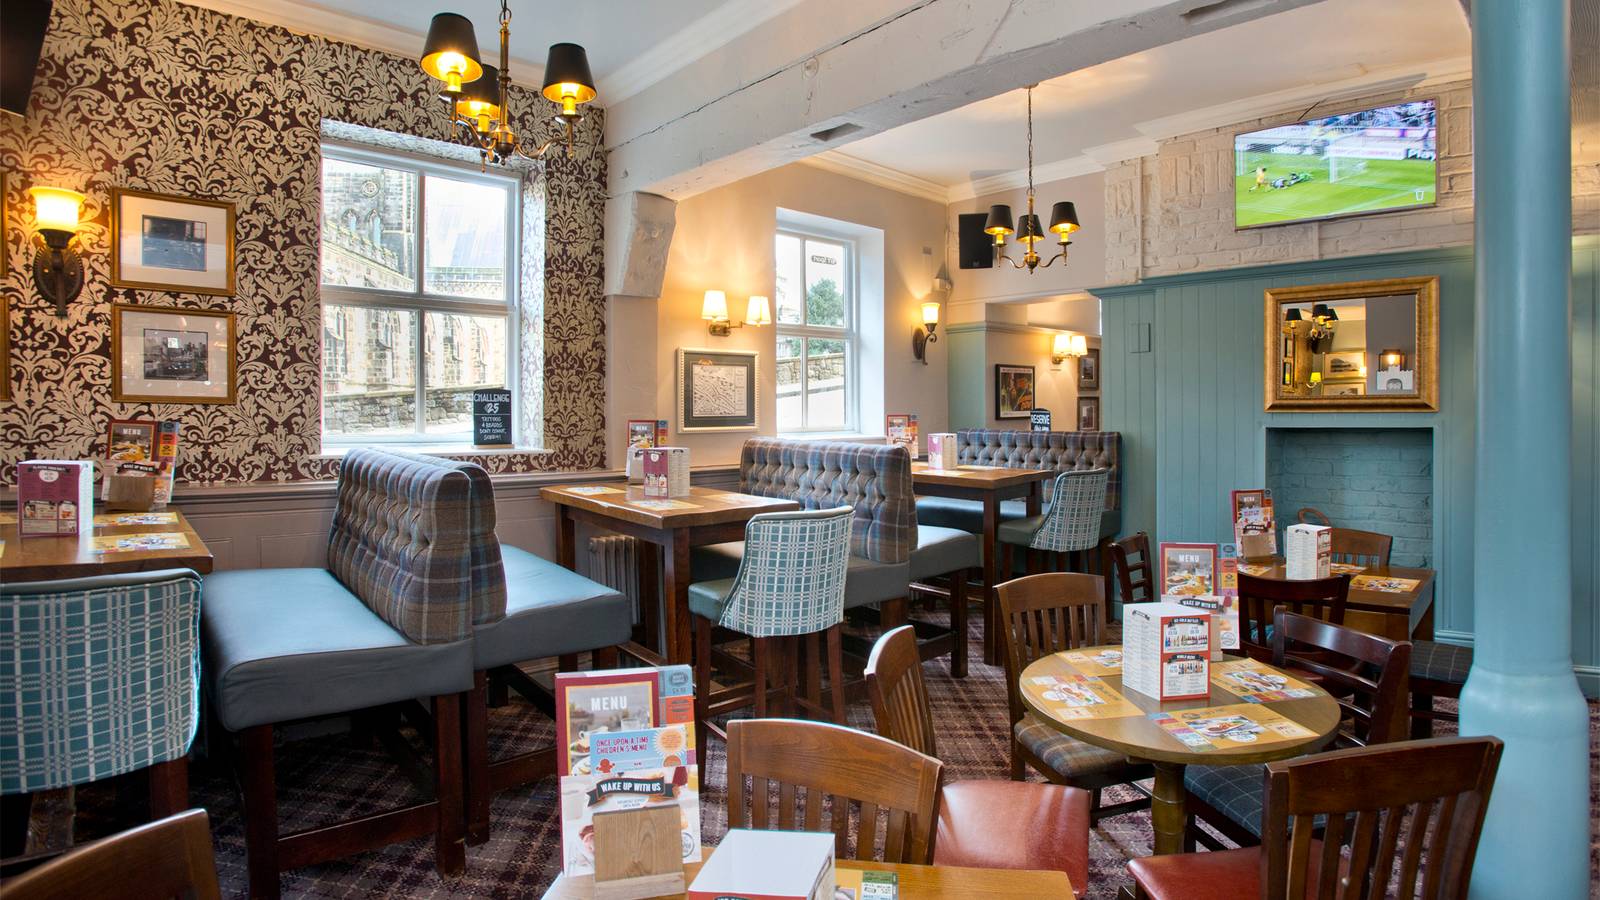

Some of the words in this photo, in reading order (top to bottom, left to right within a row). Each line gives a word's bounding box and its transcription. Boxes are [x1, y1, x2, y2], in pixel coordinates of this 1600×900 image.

[474, 394, 510, 402] CHALLENGE
[1178, 554, 1200, 562] MENU
[591, 696, 628, 711] MENU
[600, 781, 621, 792] WAKE
[622, 781, 632, 791] UP
[633, 783, 650, 792] WITH
[652, 782, 661, 791] US
